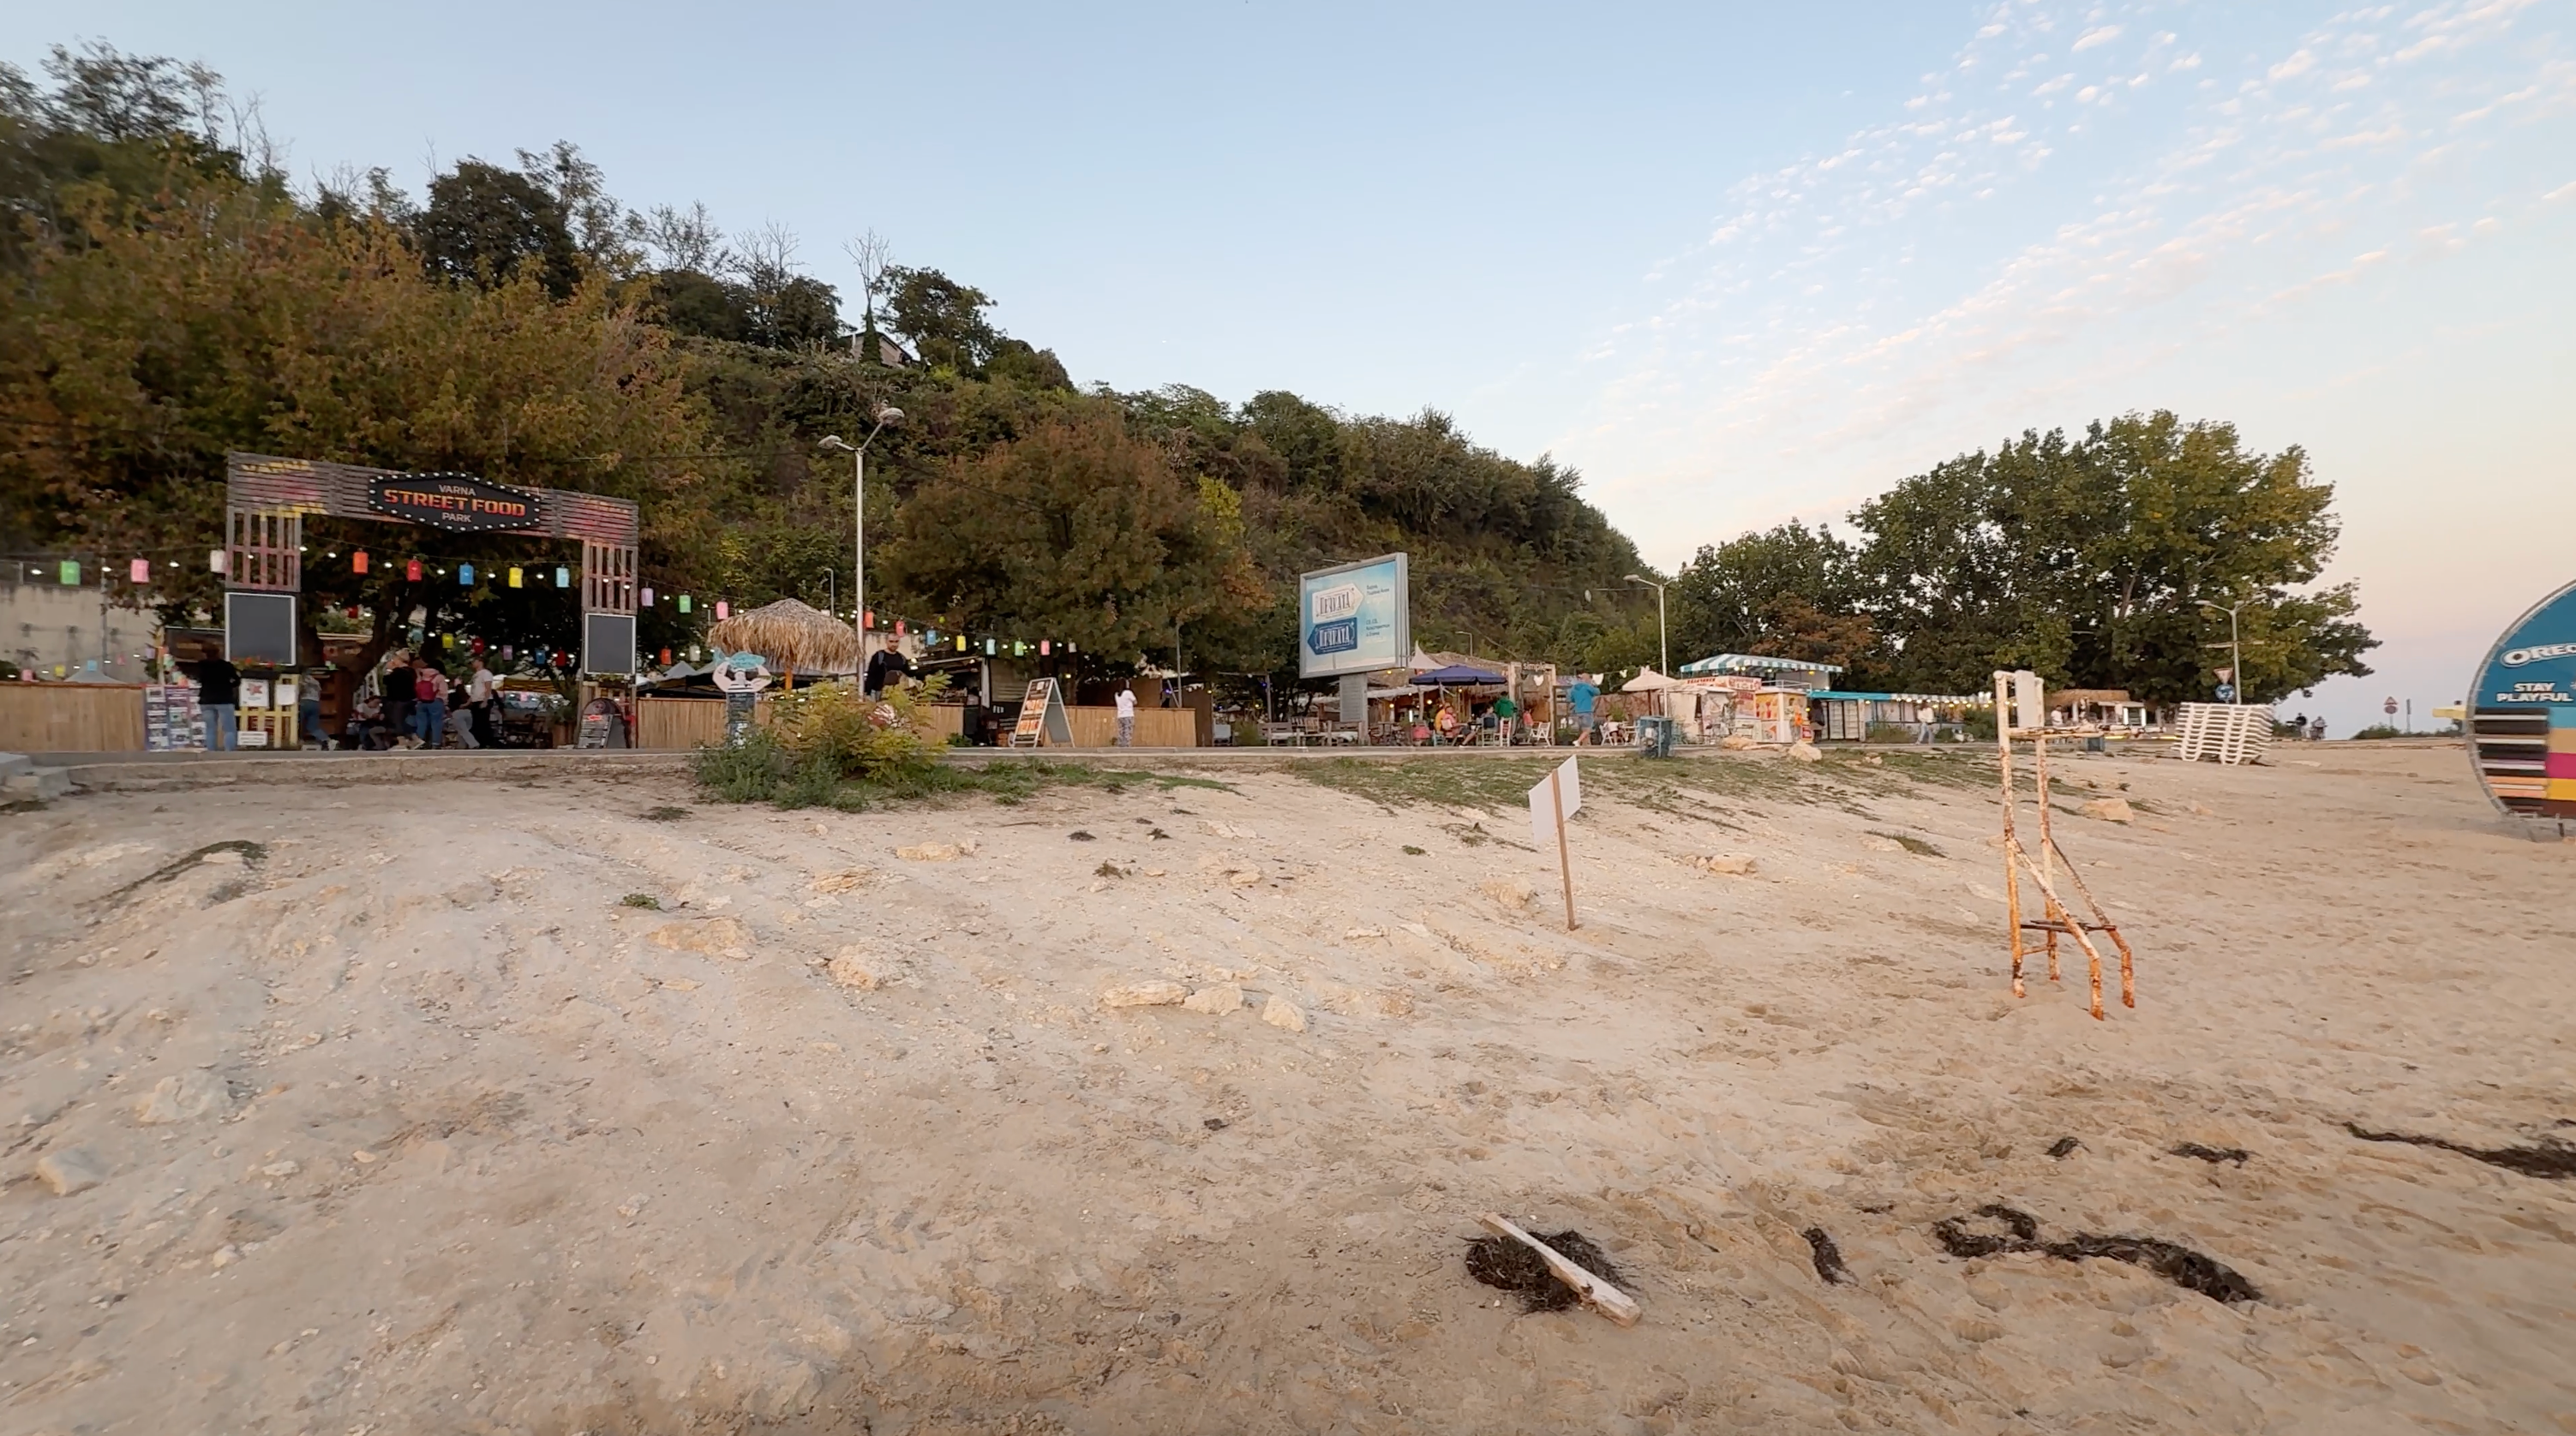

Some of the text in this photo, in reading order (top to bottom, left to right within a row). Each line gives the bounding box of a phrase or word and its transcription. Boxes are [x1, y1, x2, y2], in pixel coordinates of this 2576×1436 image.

[439, 484, 476, 496] VARNA
[384, 489, 526, 518] STREET FOOD
[441, 512, 471, 523] PARK
[2502, 643, 2576, 666] OREO
[2513, 682, 2555, 692] STAY
[2495, 692, 2574, 703] PLAYFUL
